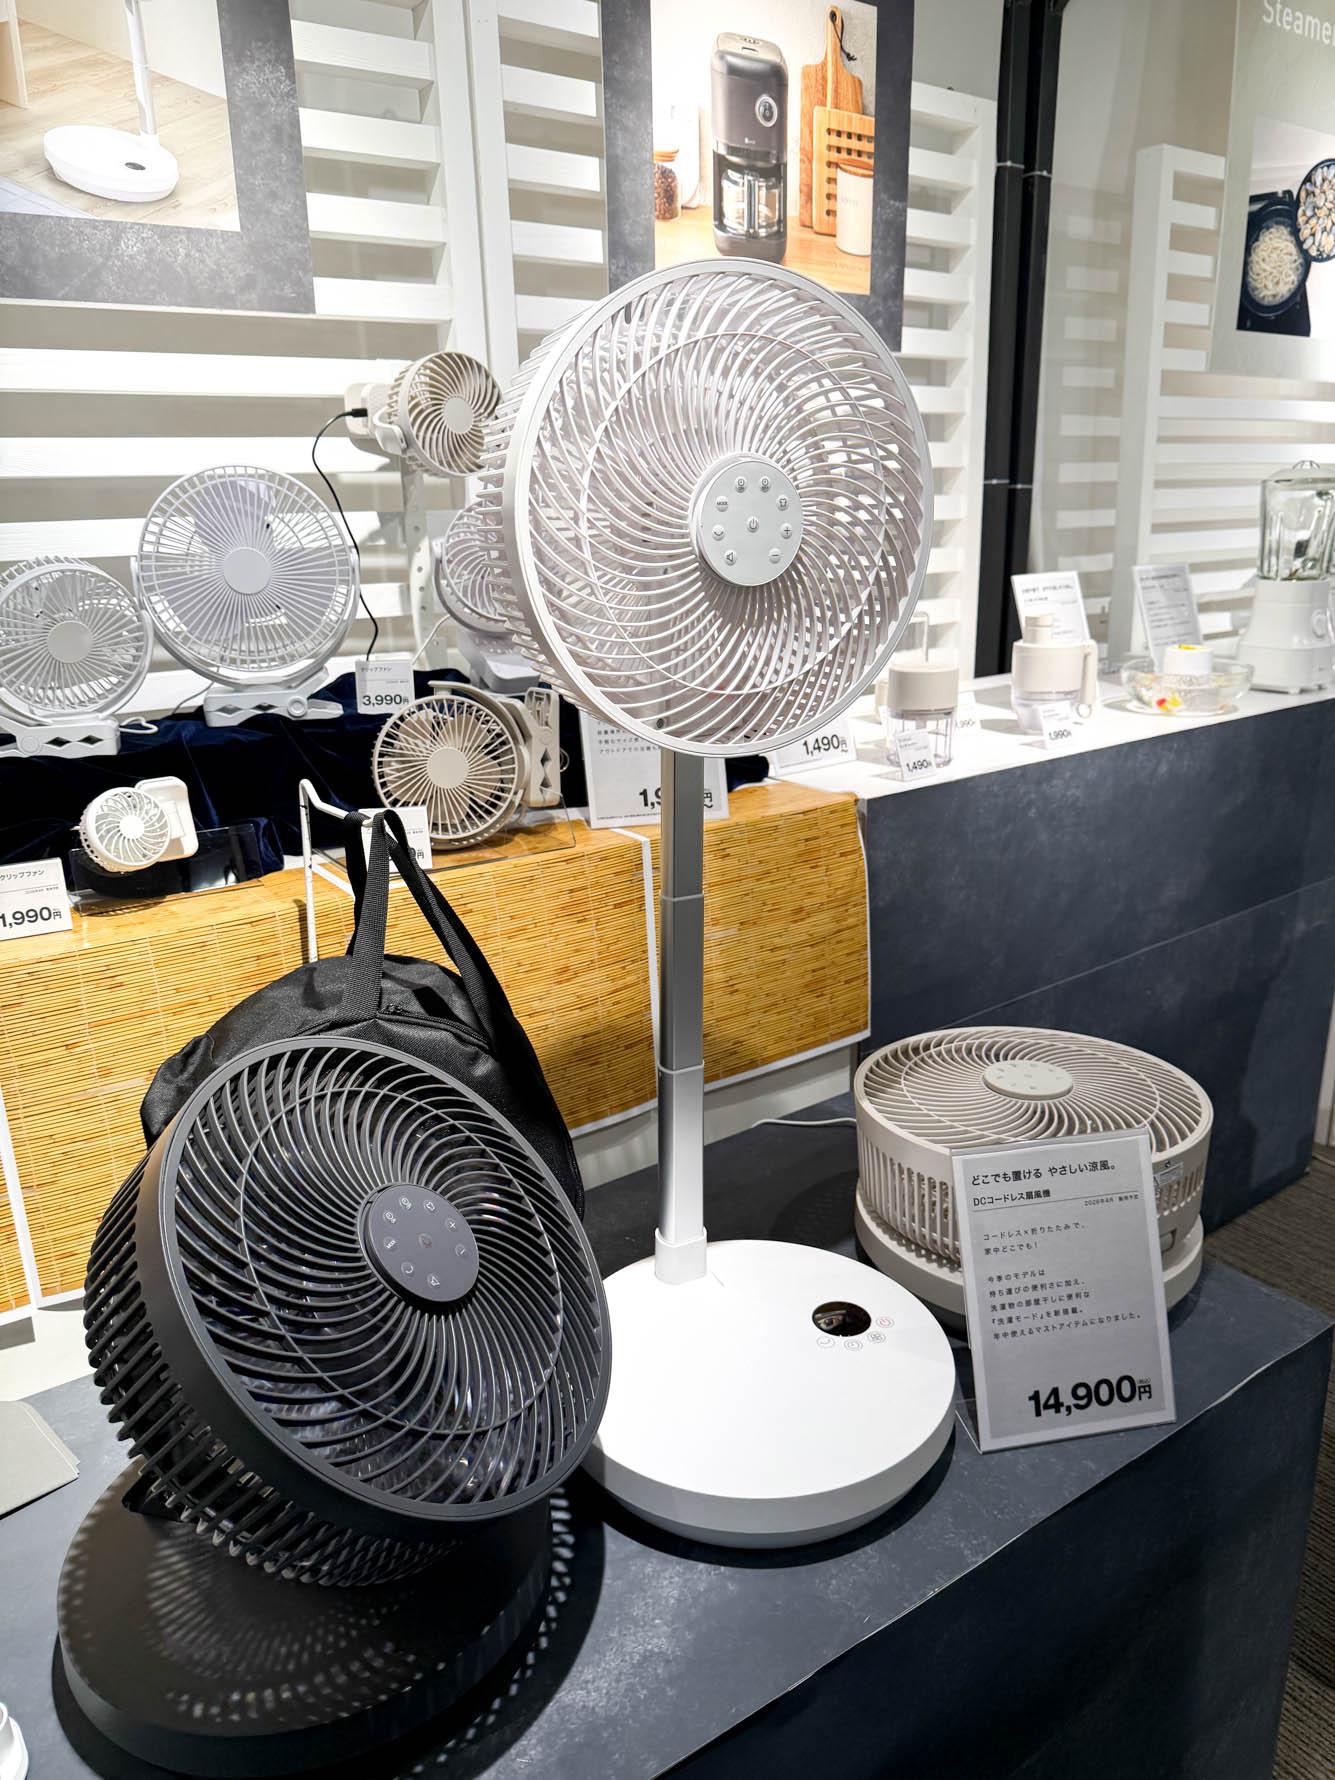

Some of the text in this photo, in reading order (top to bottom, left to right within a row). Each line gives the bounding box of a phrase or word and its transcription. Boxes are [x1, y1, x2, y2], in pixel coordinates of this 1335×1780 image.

[1263, 0, 1335, 46] Steame
[971, 1160, 1116, 1186] どこでも置ける やさしい涼風。
[973, 1189, 1051, 1207] DCコードレス扇風機
